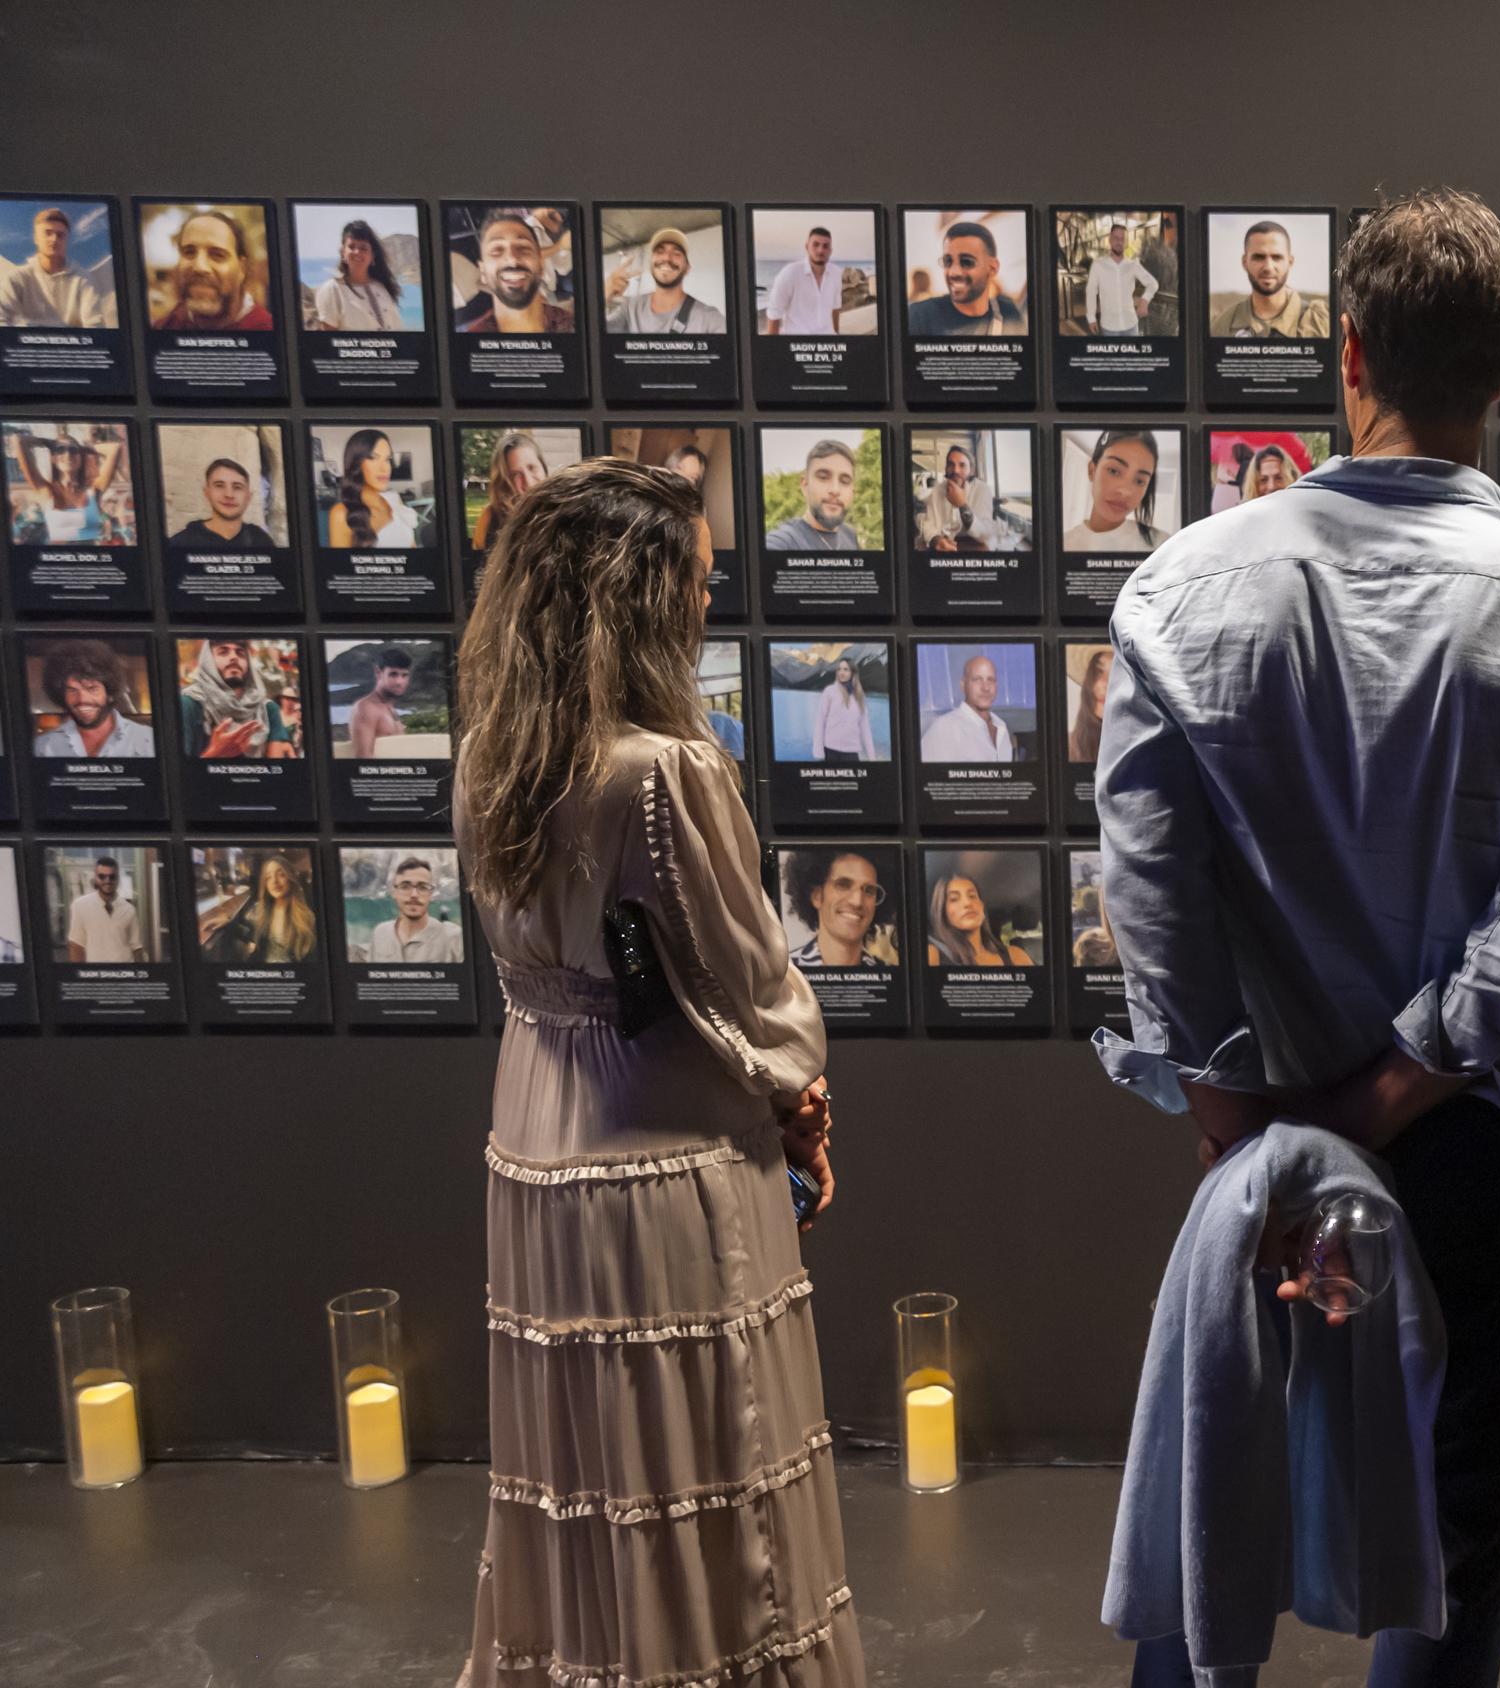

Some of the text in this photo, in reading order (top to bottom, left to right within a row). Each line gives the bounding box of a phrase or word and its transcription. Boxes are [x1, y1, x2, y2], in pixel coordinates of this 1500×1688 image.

[479, 340, 500, 350] RON
[541, 340, 553, 350] 24
[697, 341, 709, 351] 23
[817, 343, 847, 352] BAYLIN
[915, 343, 1023, 353] SHAHAK YOSEF MADAR, 26
[1086, 343, 1152, 353] SHALEV GAL, 25
[1224, 345, 1261, 354] SHARON
[1304, 345, 1315, 354] 25
[795, 353, 813, 362] BEN
[832, 353, 843, 362] 24
[787, 557, 864, 567] SAHAR ASHUAN, 22
[930, 559, 1019, 568] SHAHAR BEN NAIM, 42
[1086, 559, 1112, 568] SHANI
[359, 766, 379, 775] RON
[800, 768, 824, 778] SAPIR
[857, 768, 867, 778] 24
[948, 770, 1013, 779] SHAI SHALEV, 50
[826, 973, 843, 982] GAL
[947, 972, 980, 982] SHAKED
[1015, 972, 1026, 982] 22
[1086, 974, 1111, 983] SHANI
